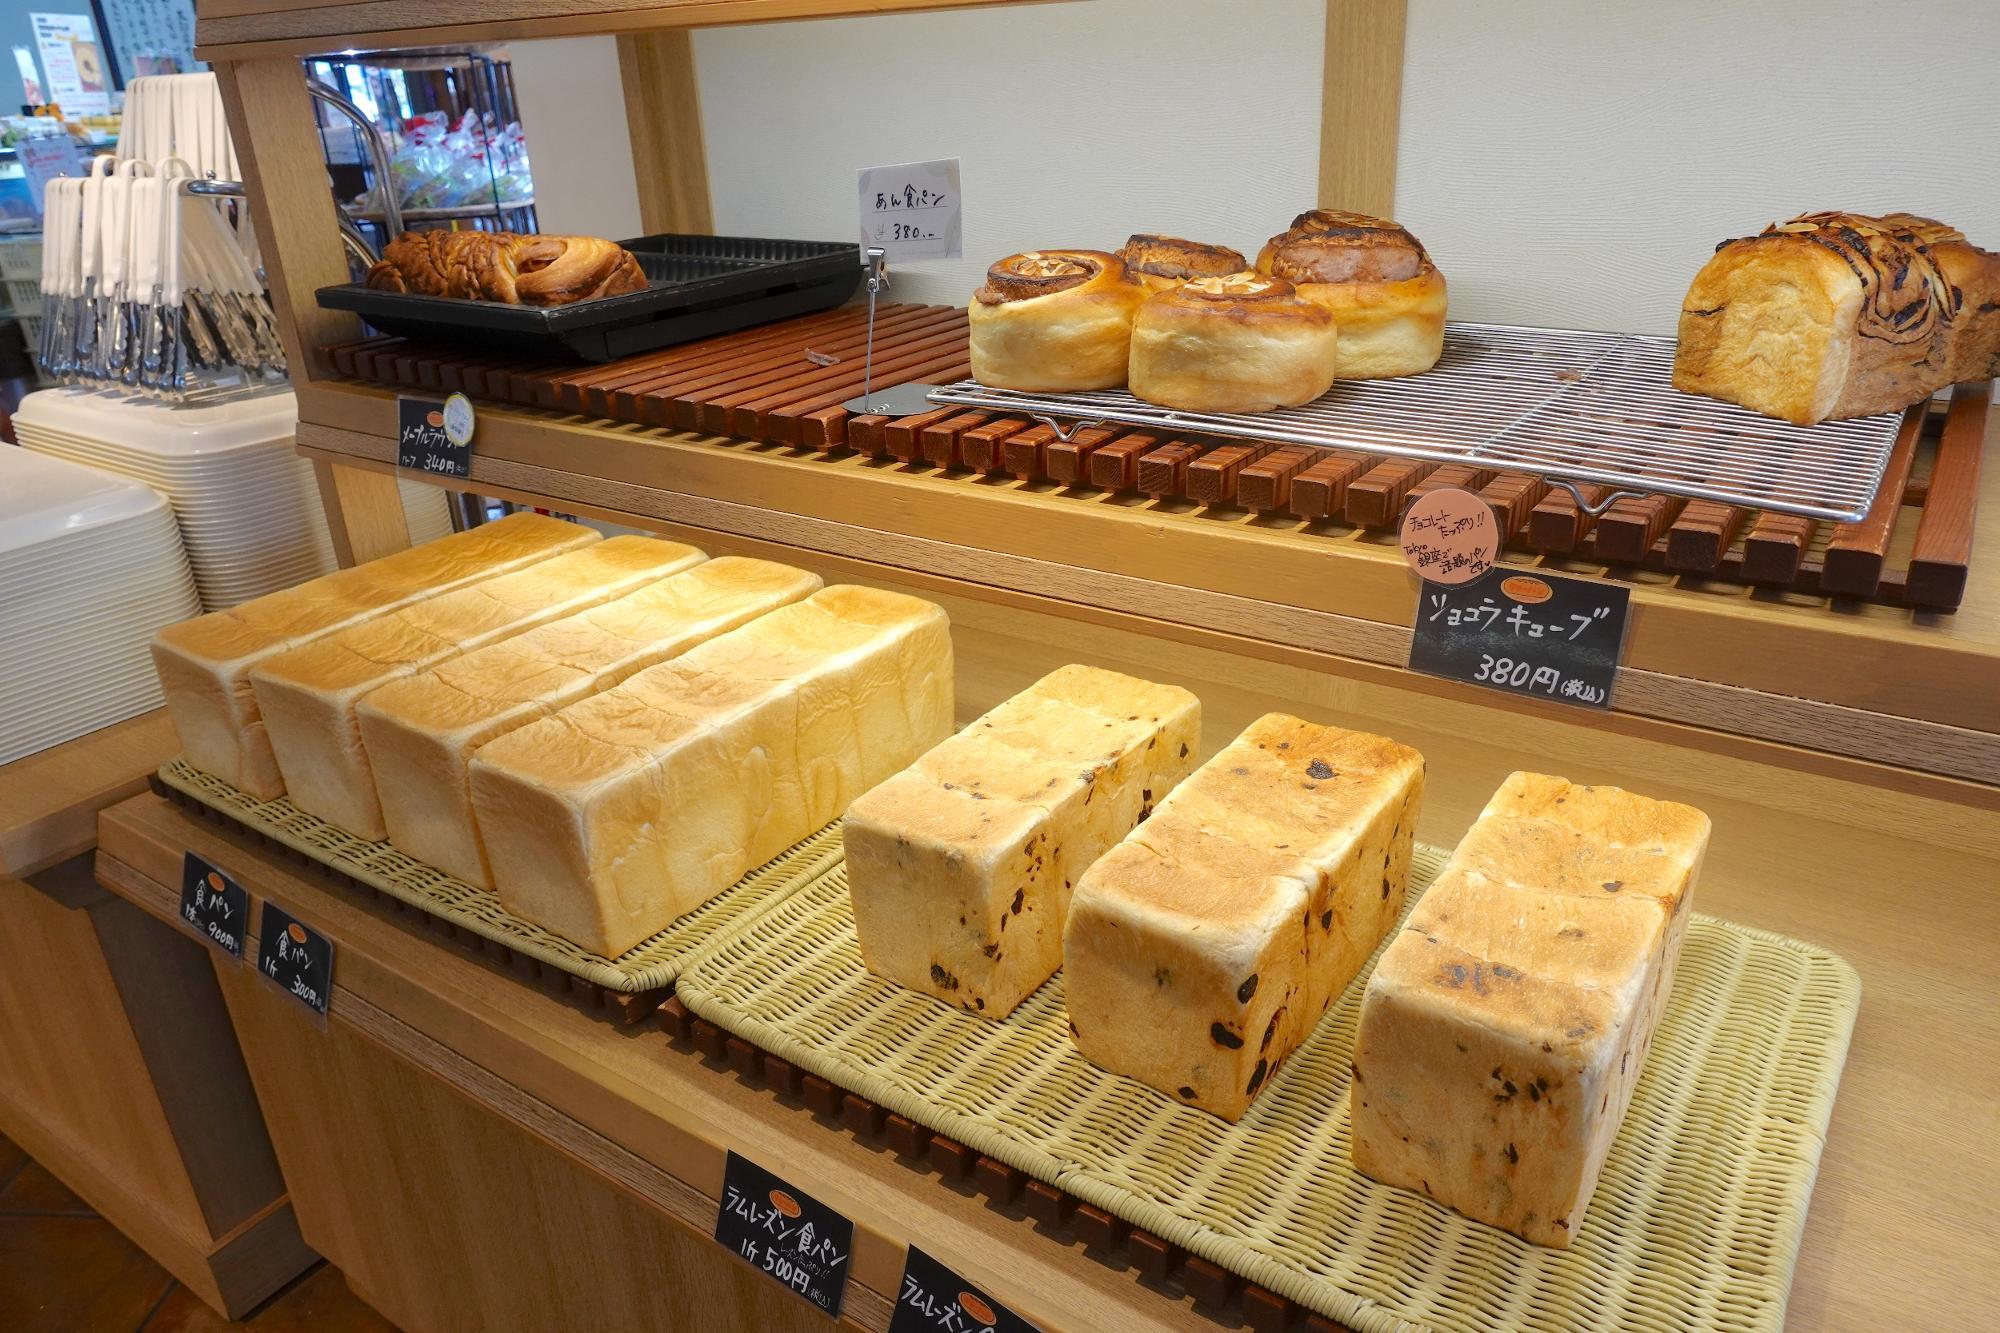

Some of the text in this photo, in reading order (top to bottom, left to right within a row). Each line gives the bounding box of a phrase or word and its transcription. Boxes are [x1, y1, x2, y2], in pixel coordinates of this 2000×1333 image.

[876, 184, 945, 210] あん食パン
[424, 453, 455, 473] 340円
[1409, 510, 1450, 532] チョコレート
[1403, 543, 1428, 556] Tokyo
[1474, 653, 1560, 694] 380円
[195, 879, 234, 920] 食パン
[209, 921, 234, 950] 900円
[276, 930, 312, 970] 食パン
[290, 974, 316, 1006] 300円
[763, 1246, 810, 1293] 500円
